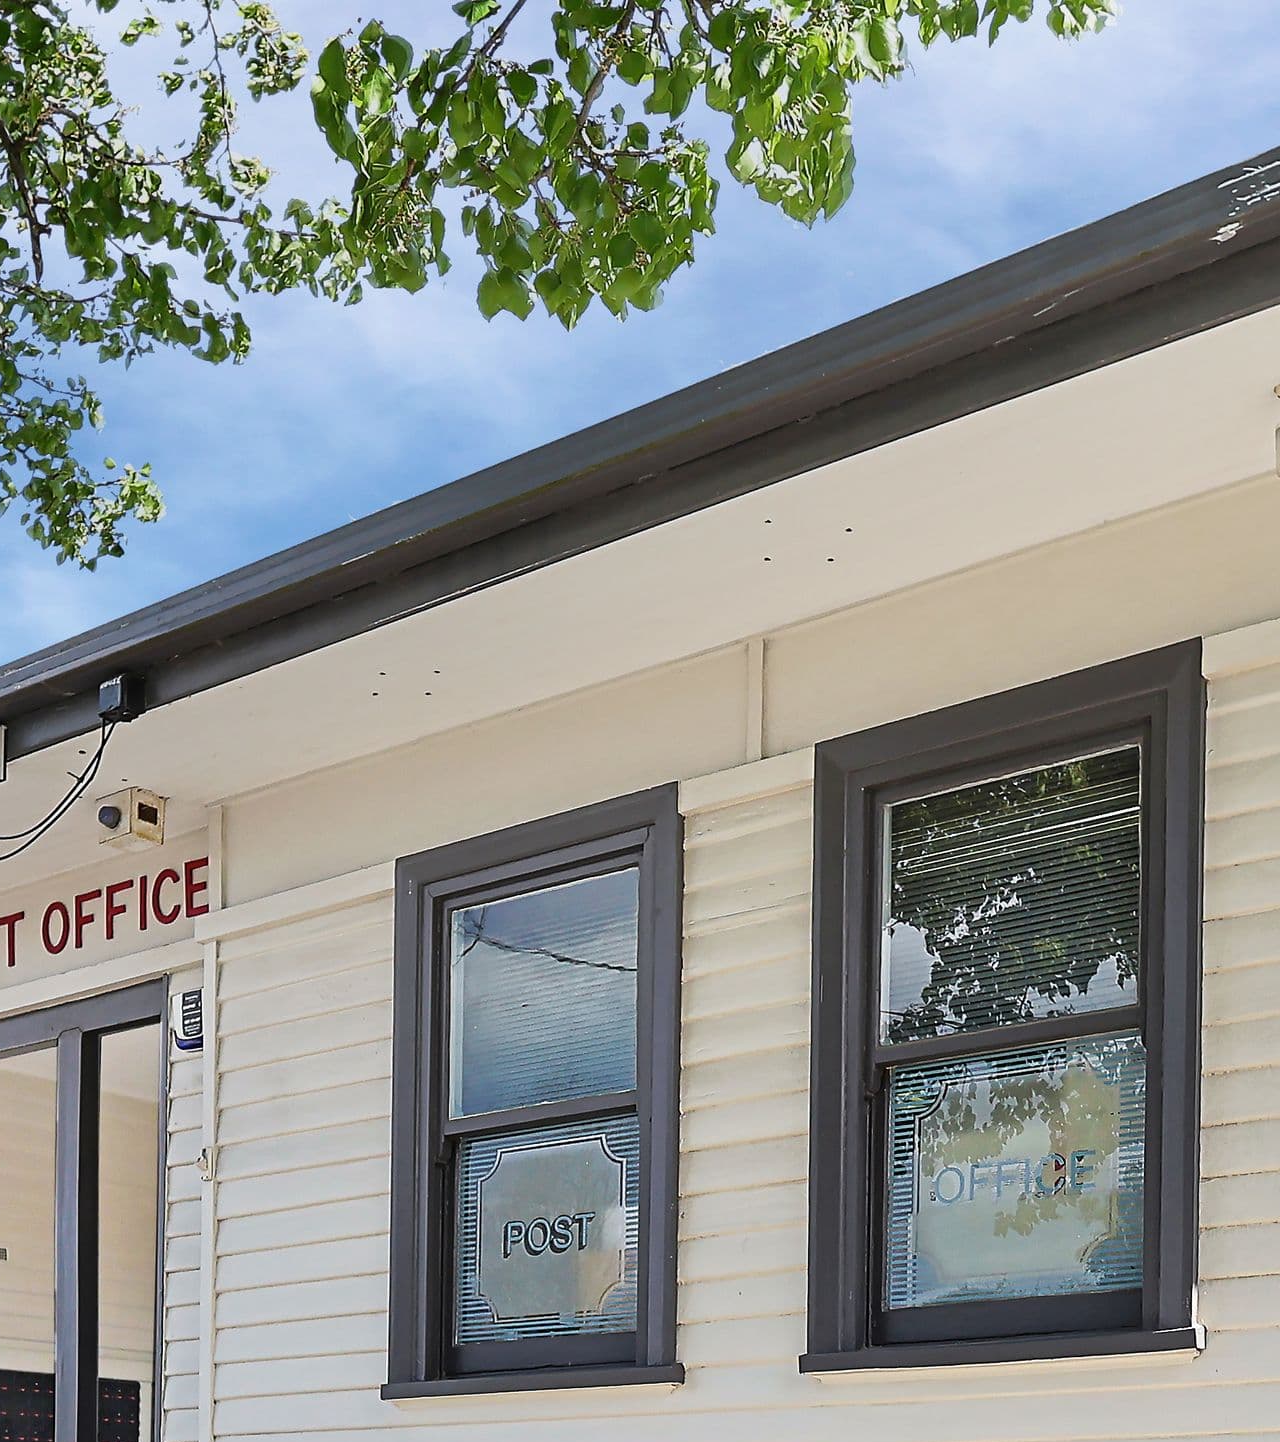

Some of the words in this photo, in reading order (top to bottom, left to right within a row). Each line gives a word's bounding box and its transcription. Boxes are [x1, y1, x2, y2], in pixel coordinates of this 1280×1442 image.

[40, 855, 210, 956] OFFICE
[930, 1149, 1097, 1205] OFFICE
[503, 1211, 596, 1259] POST
